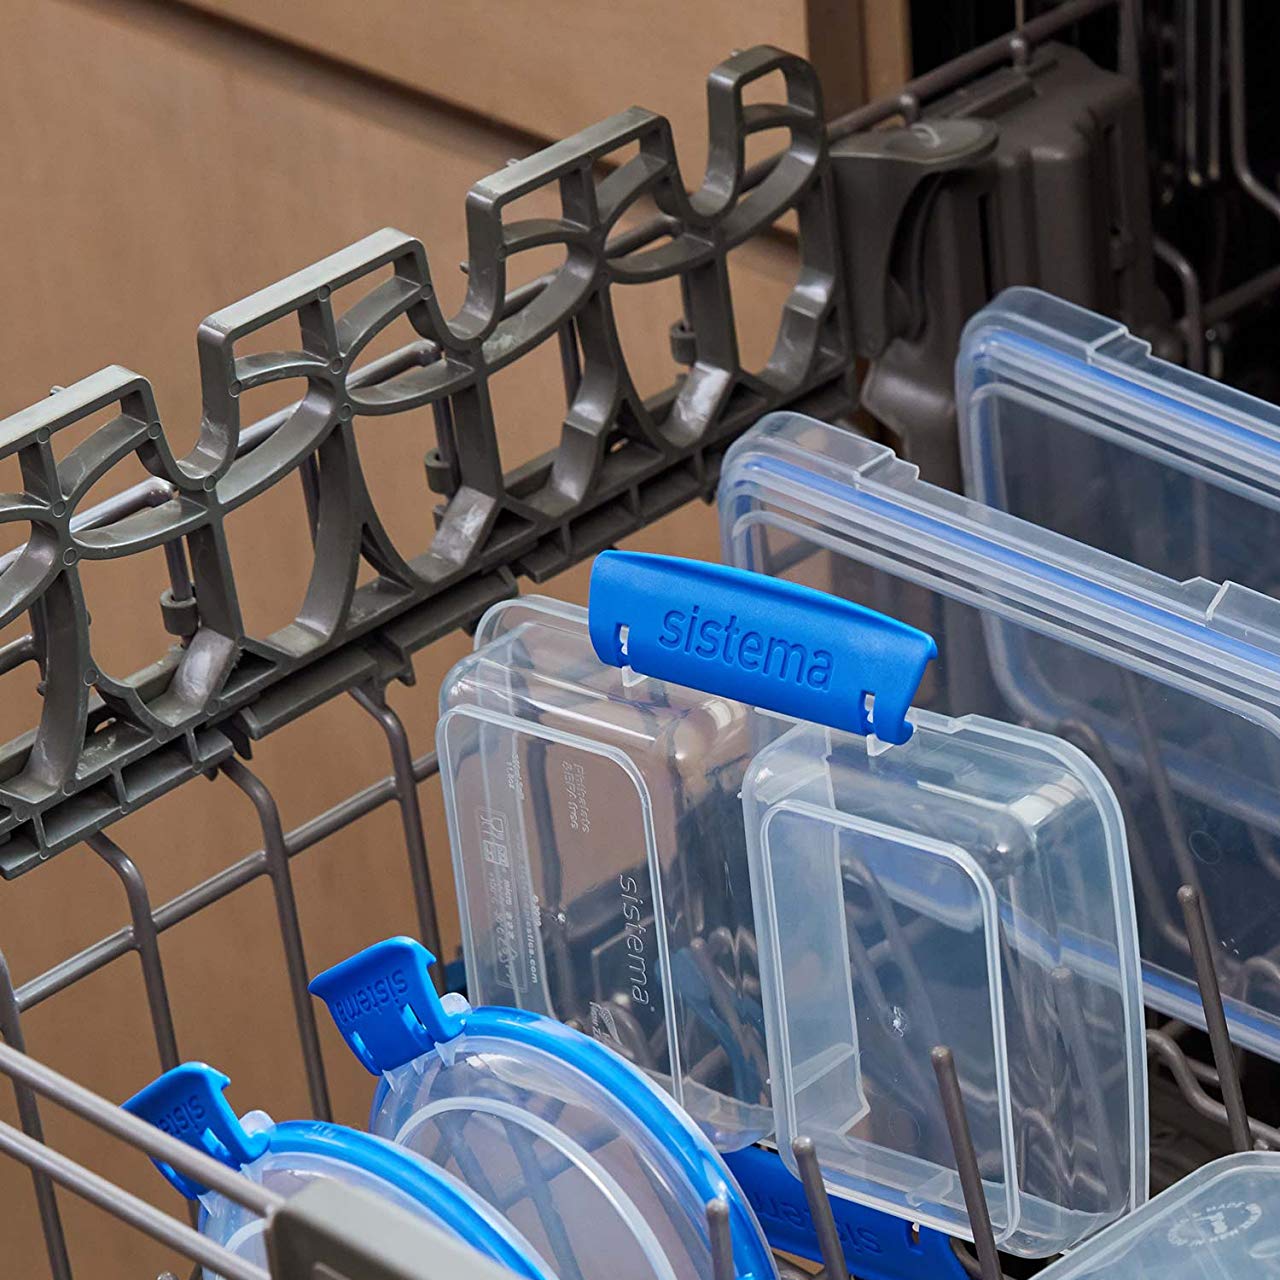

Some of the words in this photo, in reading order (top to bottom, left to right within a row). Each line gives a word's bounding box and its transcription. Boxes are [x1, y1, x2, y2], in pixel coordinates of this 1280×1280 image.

[658, 605, 834, 691] sistema
[619, 874, 649, 1005] sistema
[335, 968, 408, 1024] sistema
[157, 1095, 205, 1136] siste
